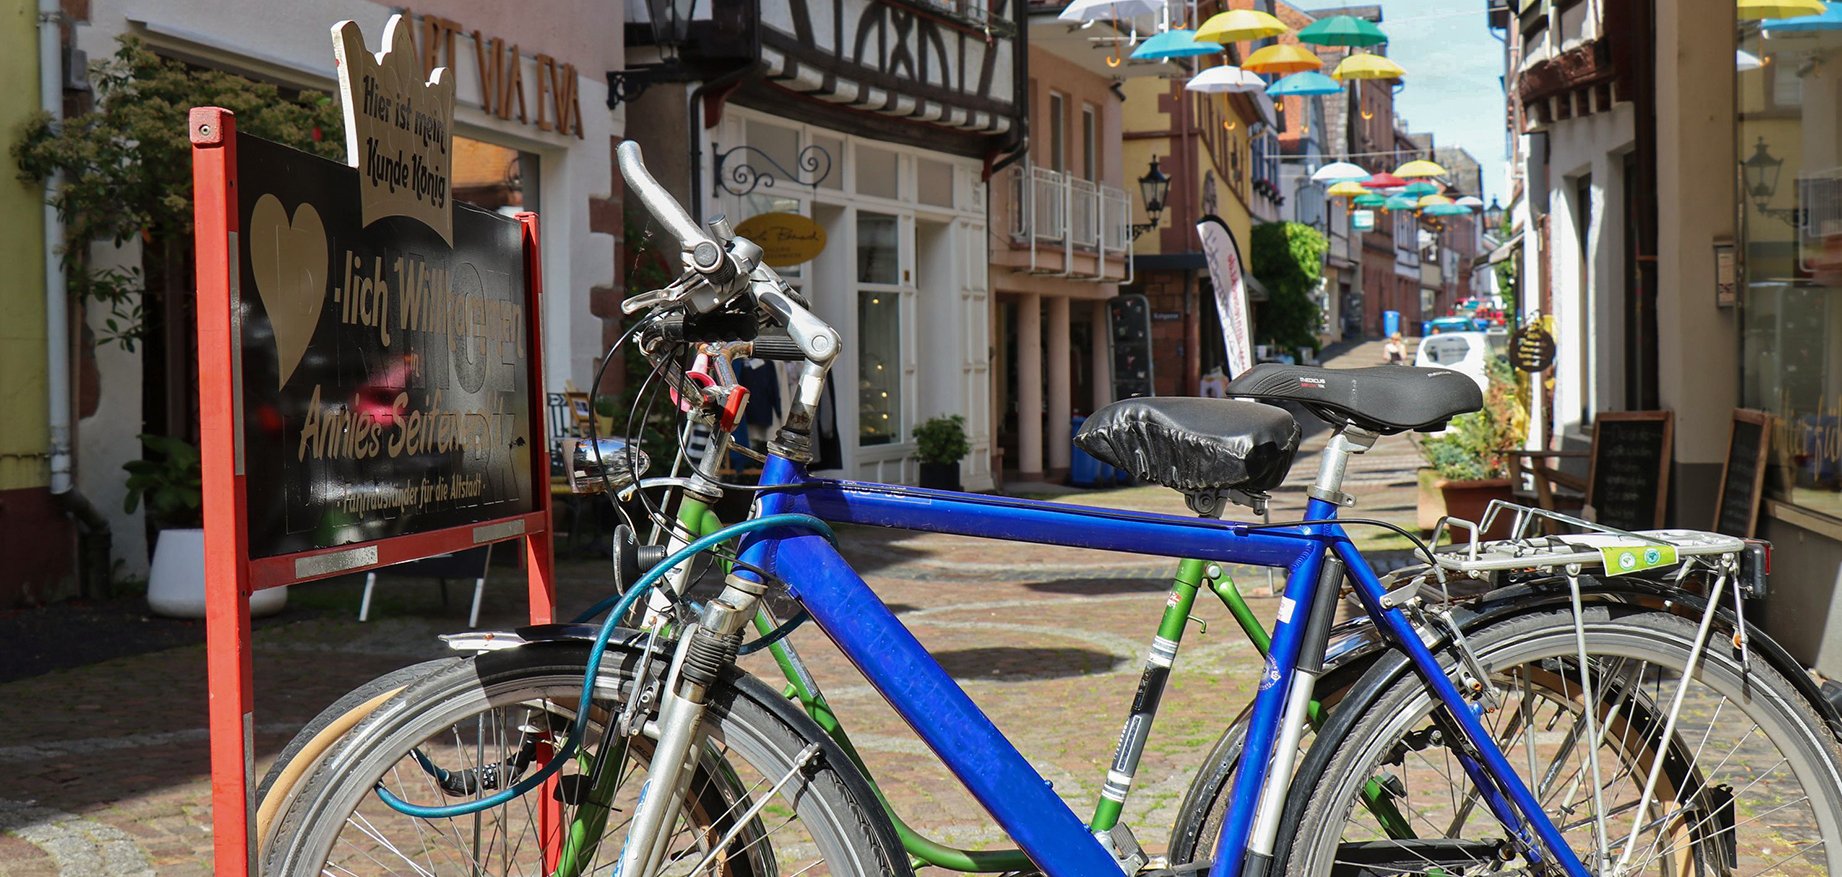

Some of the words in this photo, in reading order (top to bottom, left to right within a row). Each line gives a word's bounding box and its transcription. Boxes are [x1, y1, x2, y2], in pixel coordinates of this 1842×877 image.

[363, 74, 391, 123] Hier
[395, 94, 412, 131] ist
[414, 108, 446, 155] mein
[473, 29, 528, 126] VIA
[536, 52, 585, 140] EVA
[366, 136, 409, 194] Kunde
[411, 153, 446, 209] König
[394, 256, 524, 360] Willkommen
[411, 347, 420, 378] in
[298, 384, 382, 463] Annies
[343, 479, 418, 519] Fahrradständer
[419, 477, 434, 509] für
[435, 475, 448, 501] die
[451, 472, 481, 500] Altstadt
